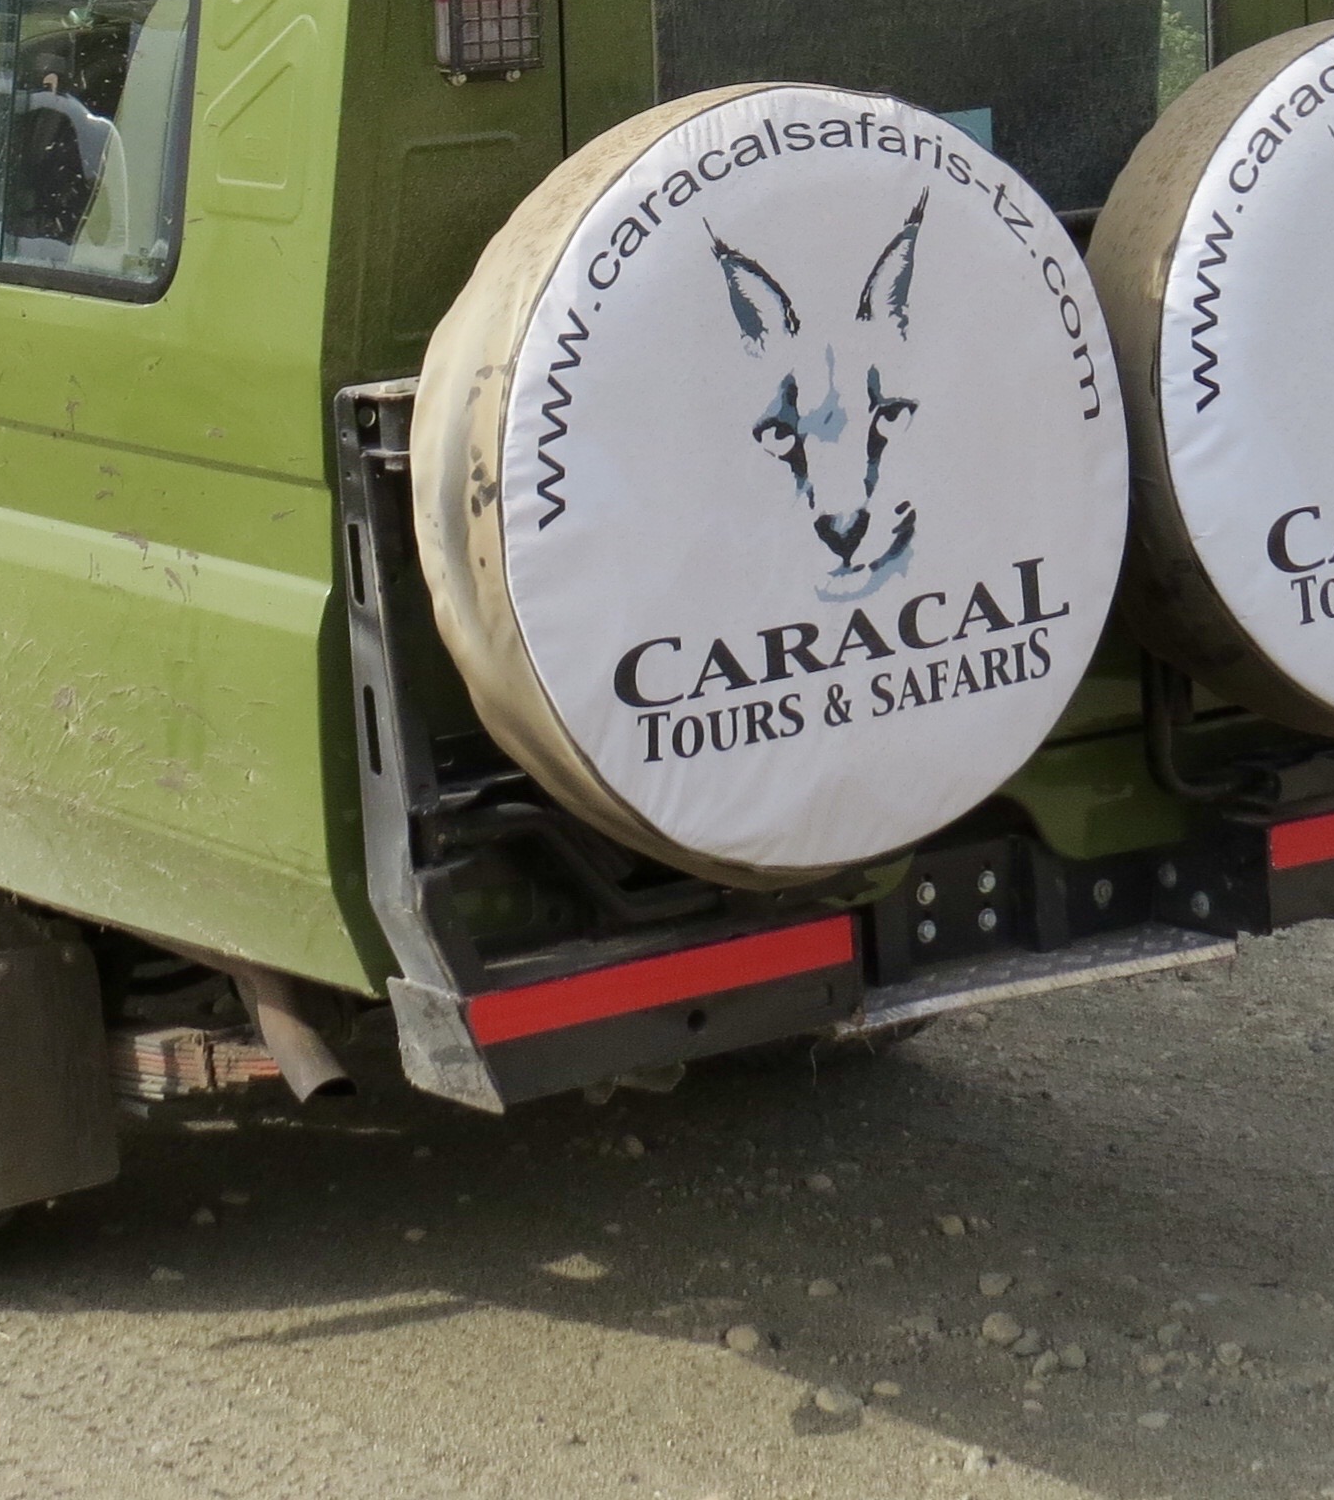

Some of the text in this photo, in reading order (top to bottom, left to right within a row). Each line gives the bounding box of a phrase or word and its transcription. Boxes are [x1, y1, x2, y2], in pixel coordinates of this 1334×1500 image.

[537, 111, 1101, 531] www.caracalsafaris-tz.com
[613, 557, 1070, 708] CARACAL
[637, 626, 1051, 763] TOURS & SAFARIS
